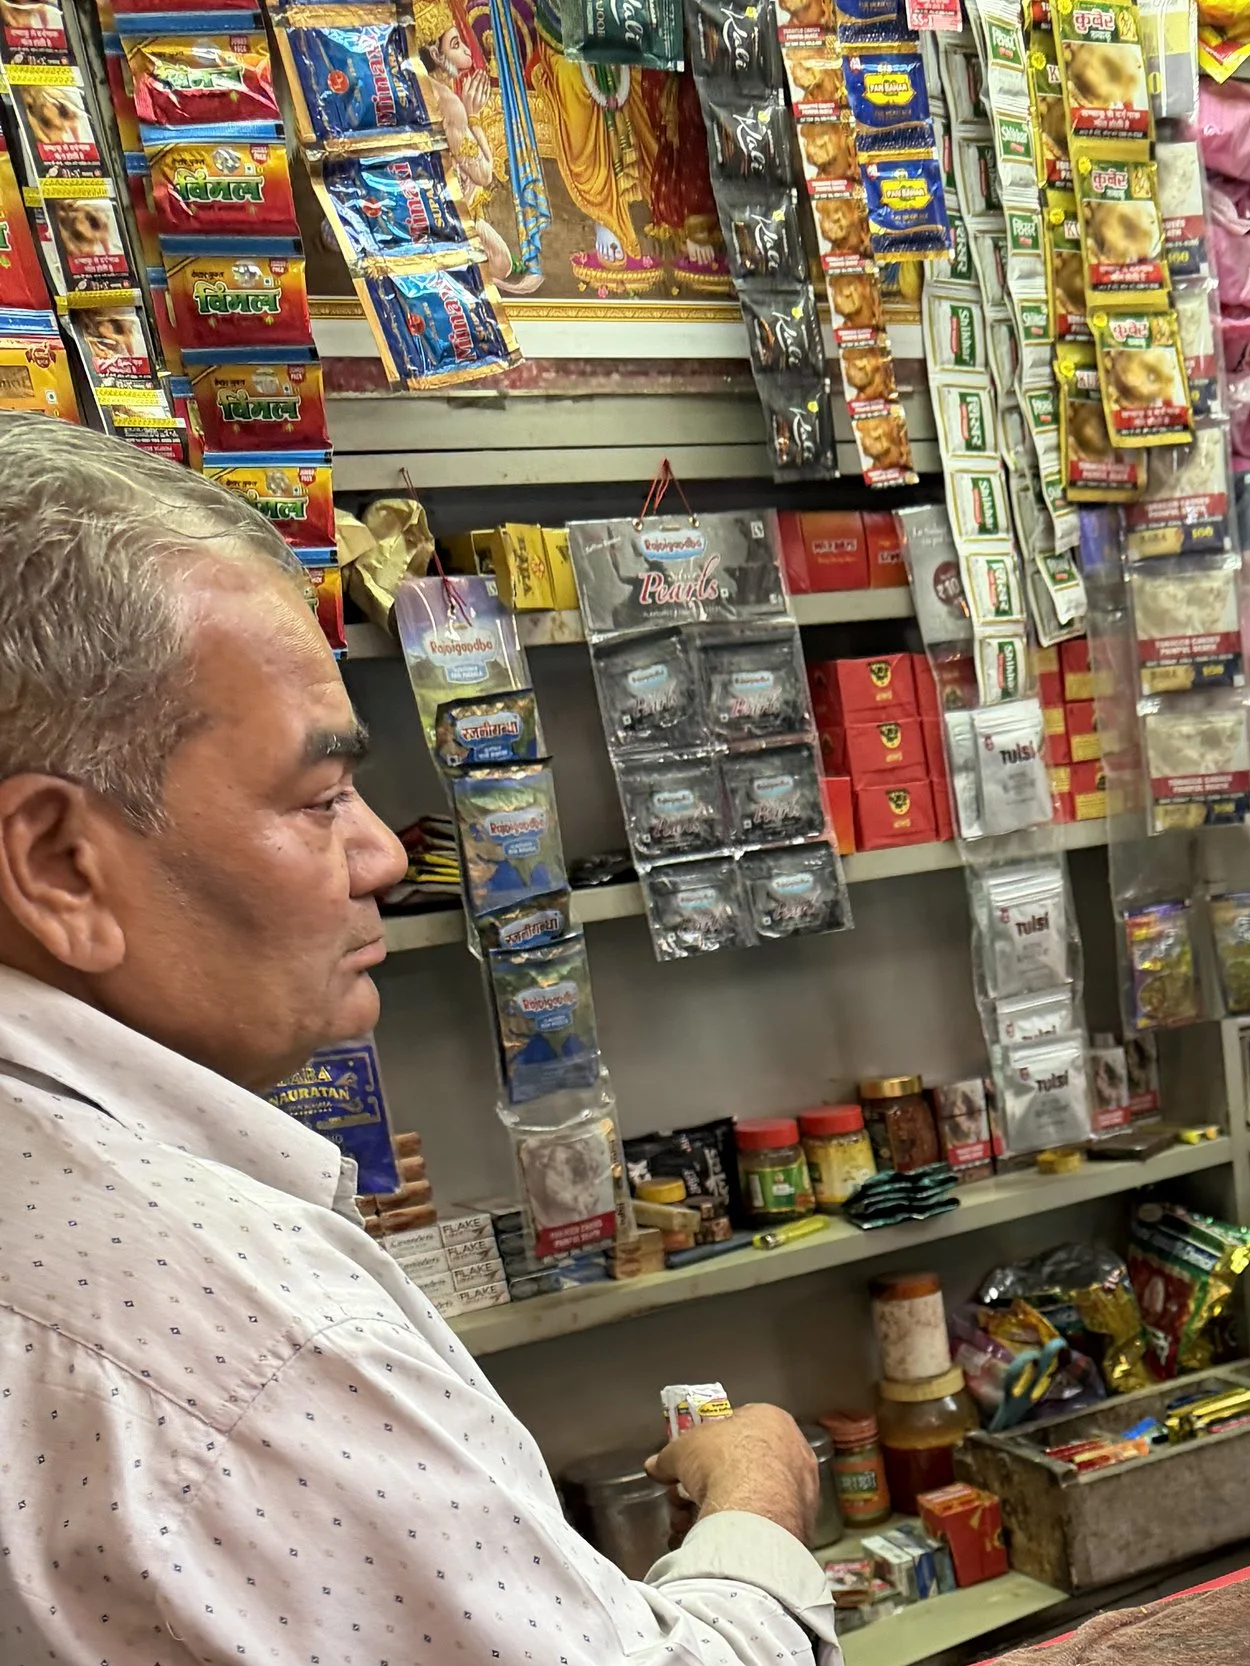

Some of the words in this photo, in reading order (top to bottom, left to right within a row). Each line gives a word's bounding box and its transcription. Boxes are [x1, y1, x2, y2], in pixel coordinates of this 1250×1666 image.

[194, 281, 282, 315] विमल
[217, 389, 302, 422] विमल
[636, 553, 721, 605] Pearls
[1000, 741, 1036, 765] Tulsi
[1015, 911, 1050, 937] Tulsi
[276, 1066, 333, 1087] ABA
[442, 1217, 482, 1235] FLAKE
[447, 1240, 488, 1257] FLAKE
[453, 1262, 494, 1280] FLAKE
[459, 1284, 498, 1302] FLAKE
